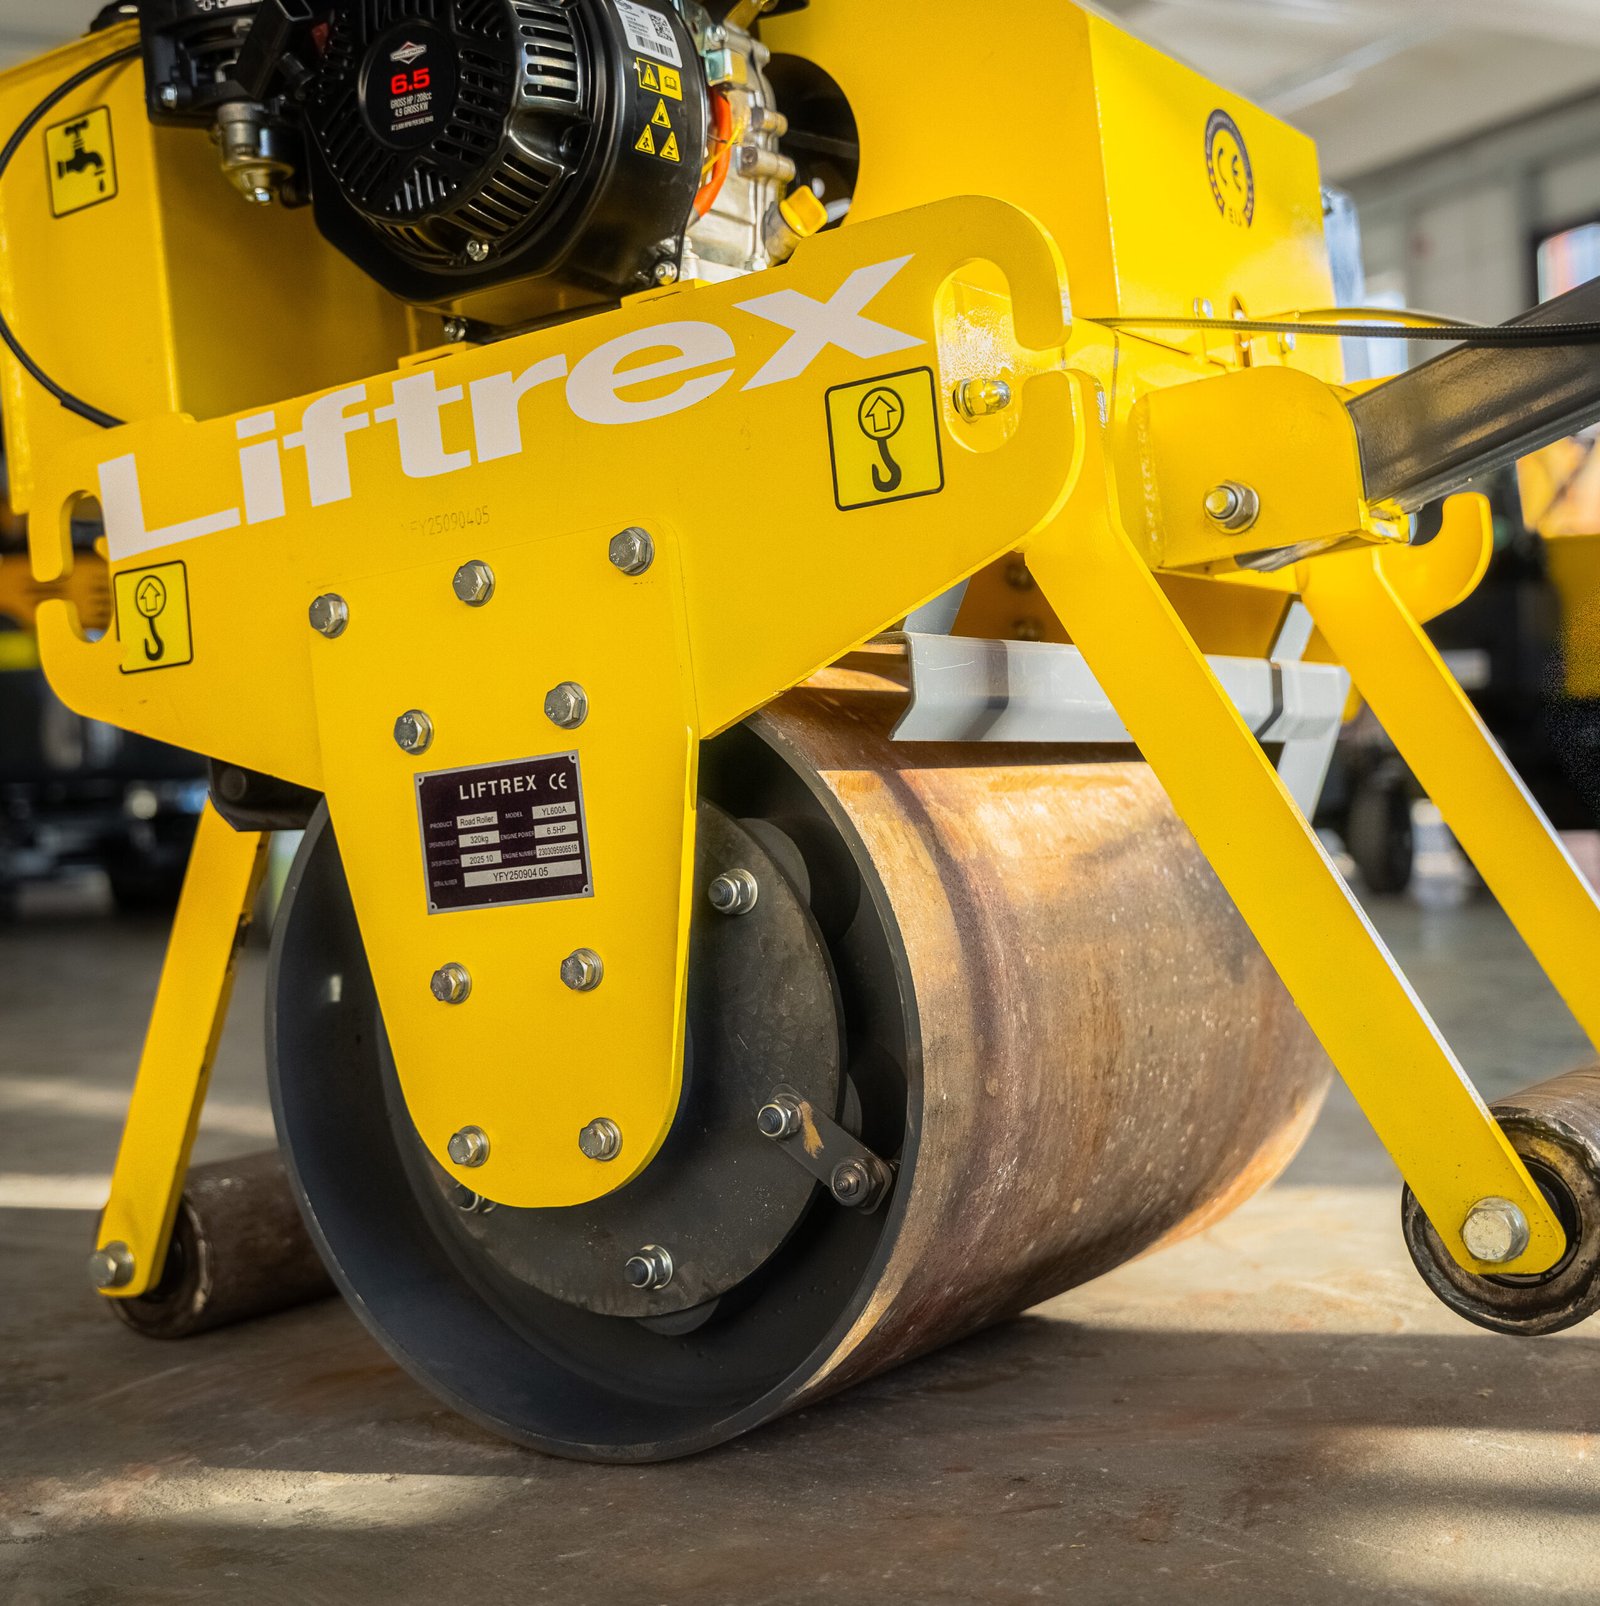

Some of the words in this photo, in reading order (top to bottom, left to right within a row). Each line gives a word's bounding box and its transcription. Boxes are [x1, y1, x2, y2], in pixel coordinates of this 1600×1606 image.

[391, 67, 431, 94] 6.5
[98, 254, 925, 560] Liftrex
[459, 774, 537, 800] LIFTREX
[505, 811, 523, 819] MODEL
[541, 805, 568, 816] YL600A
[460, 816, 475, 826] Road
[476, 815, 494, 825] Roller
[546, 825, 567, 835] 6.5HP
[470, 835, 489, 845] 320kg
